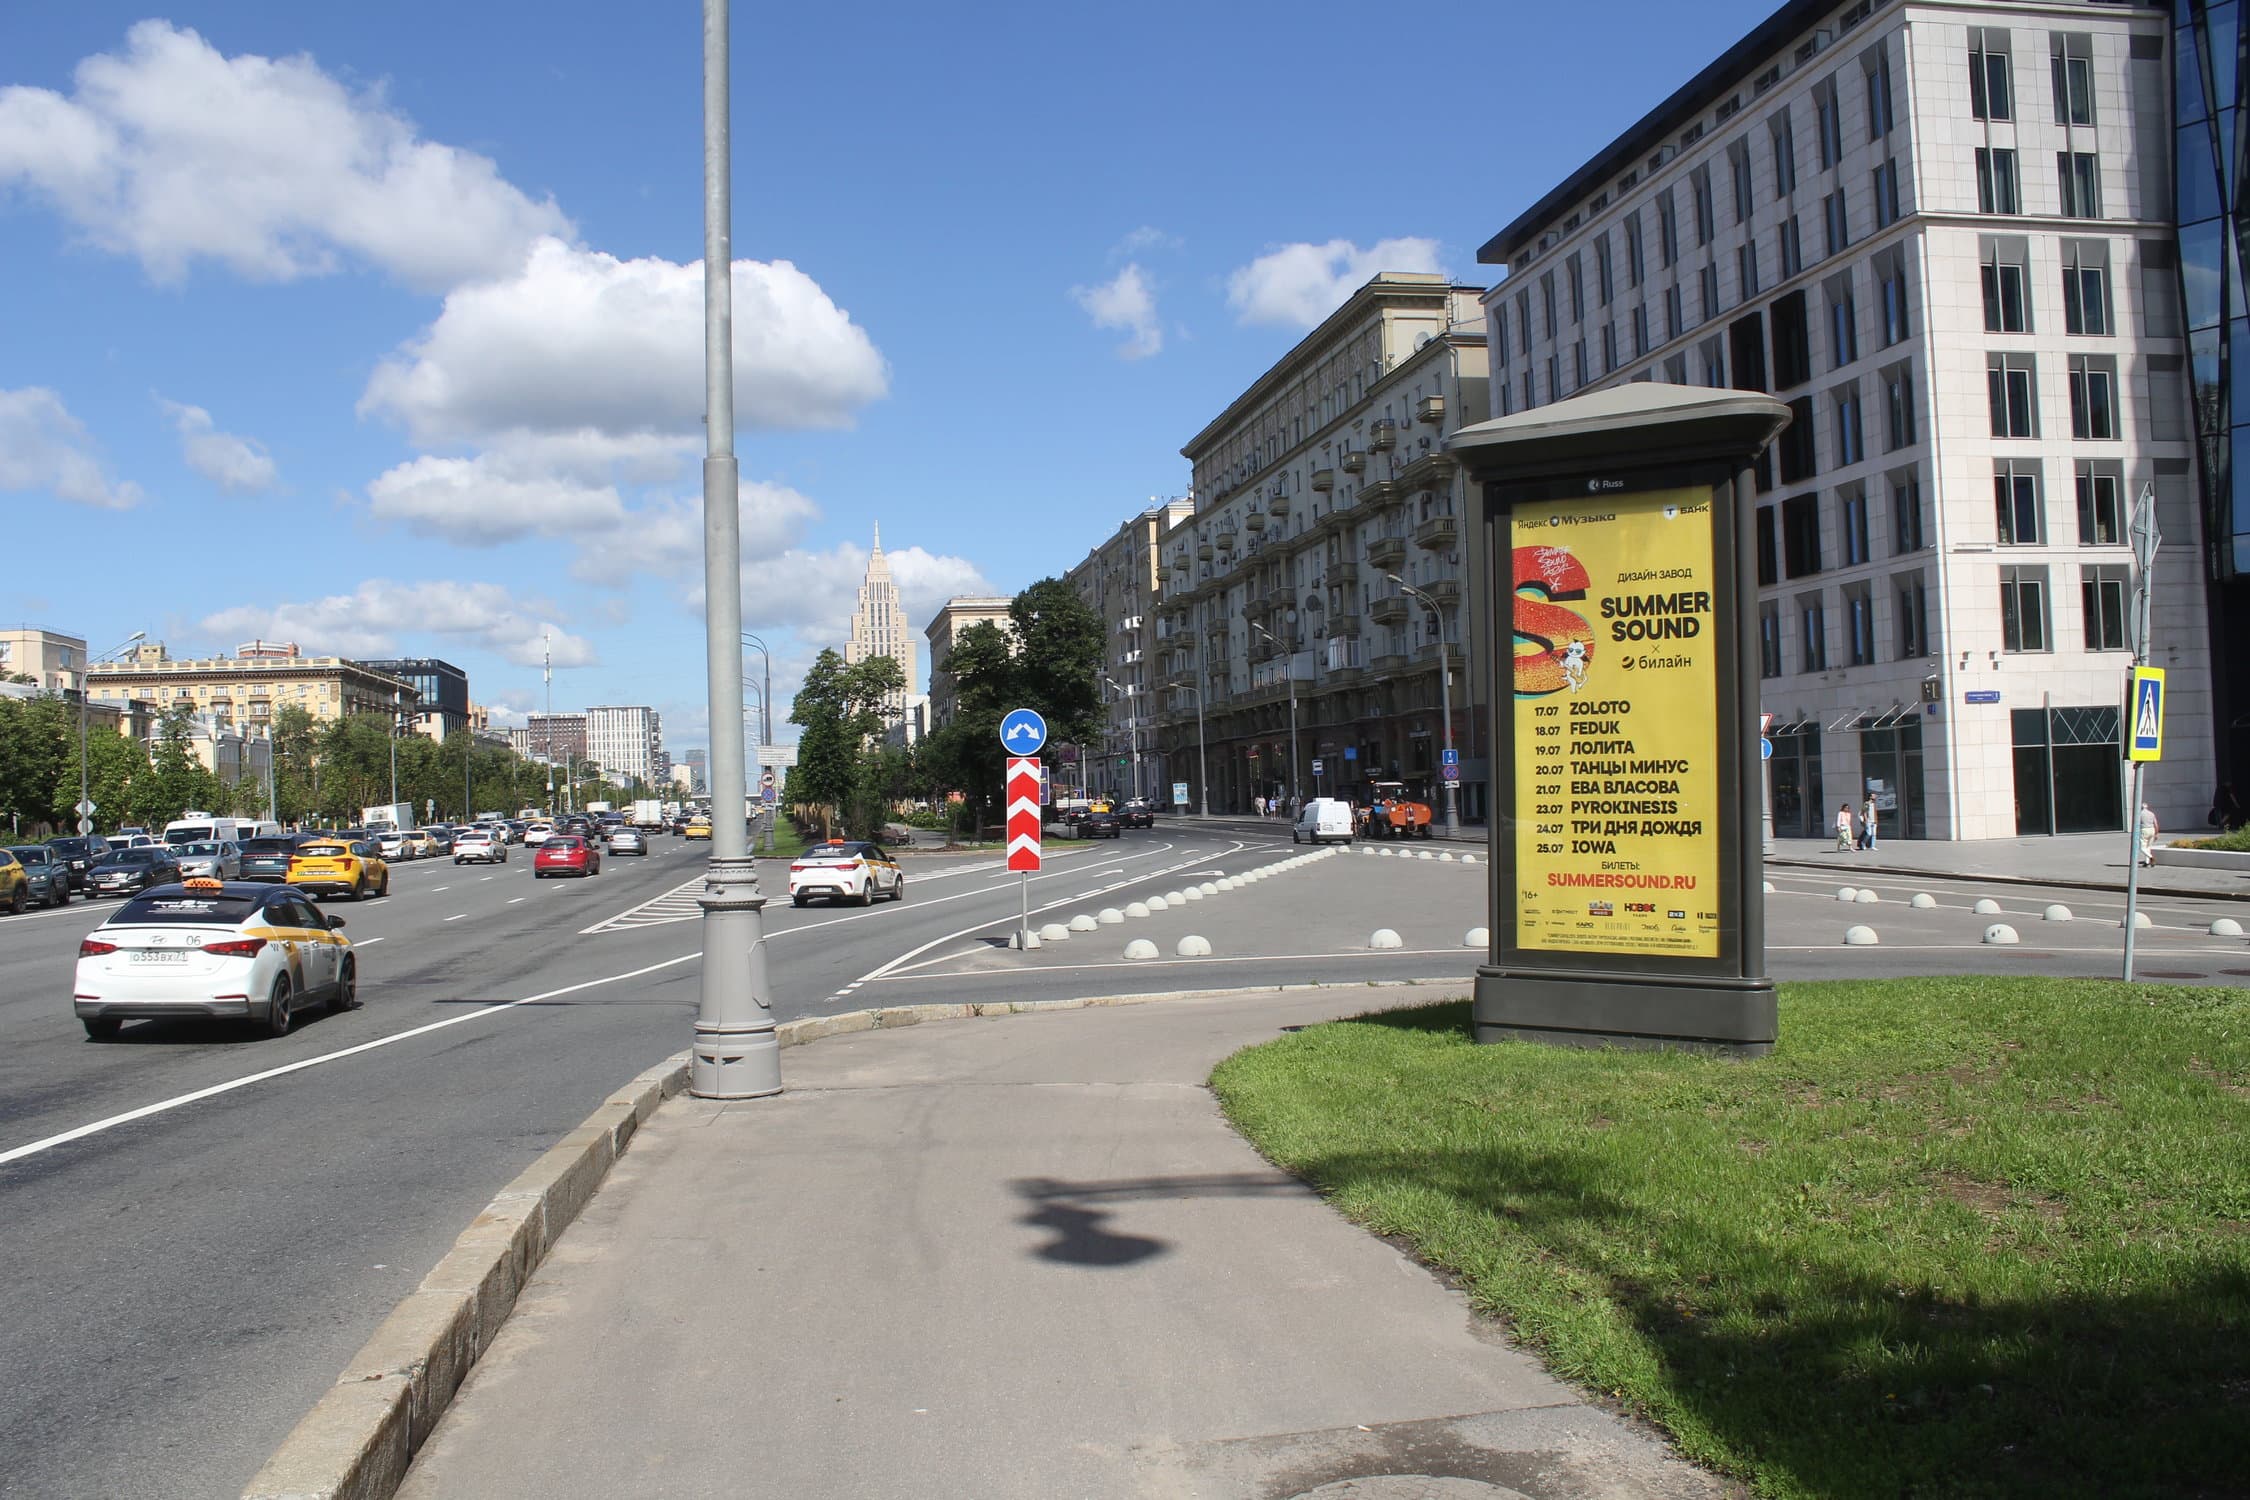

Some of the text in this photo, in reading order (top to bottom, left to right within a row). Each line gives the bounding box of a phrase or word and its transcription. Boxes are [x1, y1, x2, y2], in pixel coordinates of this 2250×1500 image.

[1602, 480, 1624, 489] Russ
[1680, 505, 1709, 515] БАНК
[1518, 513, 1616, 530] Яндекс Музыка
[1617, 567, 1692, 584] ДИЗАЙН ЗАВОД
[1600, 591, 1711, 619] SUMMER
[1611, 617, 1700, 642] SOUND
[1639, 654, 1692, 670] билайн
[1534, 700, 1631, 717] 17.07 ZOLOTO
[1535, 720, 1620, 736] 18.07 FEDUK
[1535, 741, 1635, 756] 19.07 ЛОЛИТА
[1535, 759, 1689, 777] 20.07 ТАНЦЫ МИНУС
[1535, 780, 1680, 795] 21.07 ЕВА ВЛАСОВА
[1536, 800, 1678, 815] 23.07 PYROKINESIS
[1536, 821, 1702, 837] 24.07 ТРИ ДНЯ ДОЖДЯ
[1536, 840, 1616, 855] 25.07 IOWA
[1601, 861, 1641, 871] БИЛЕТЫ:
[1547, 872, 1697, 890] SUMMERSOUND.RU
[1523, 890, 1538, 900] 16+
[186, 935, 201, 946] 06
